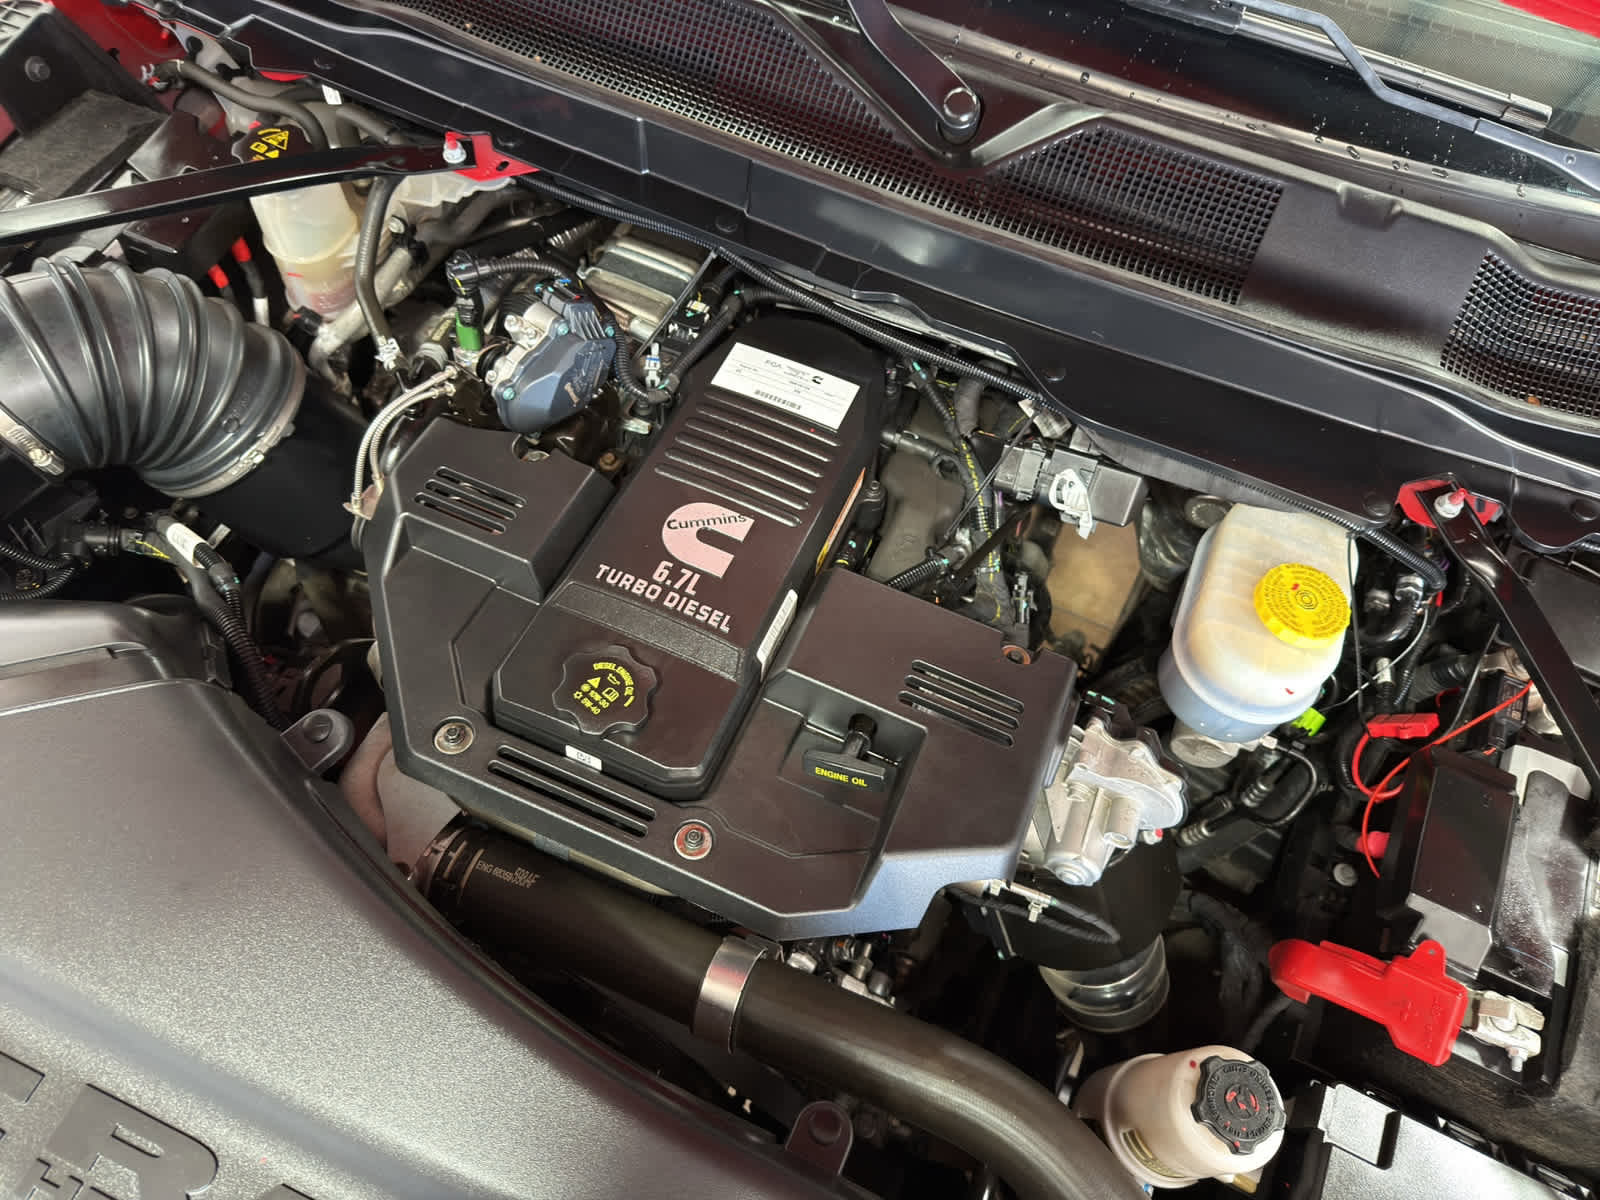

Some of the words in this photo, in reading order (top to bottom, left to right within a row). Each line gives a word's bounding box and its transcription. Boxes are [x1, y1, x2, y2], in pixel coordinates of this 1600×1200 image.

[666, 513, 747, 530] Cummins
[652, 560, 701, 596] 6.7L
[595, 564, 663, 601] TURBO
[663, 591, 731, 633] DIESEL
[815, 766, 849, 783] ENGINE
[851, 777, 868, 787] OIL
